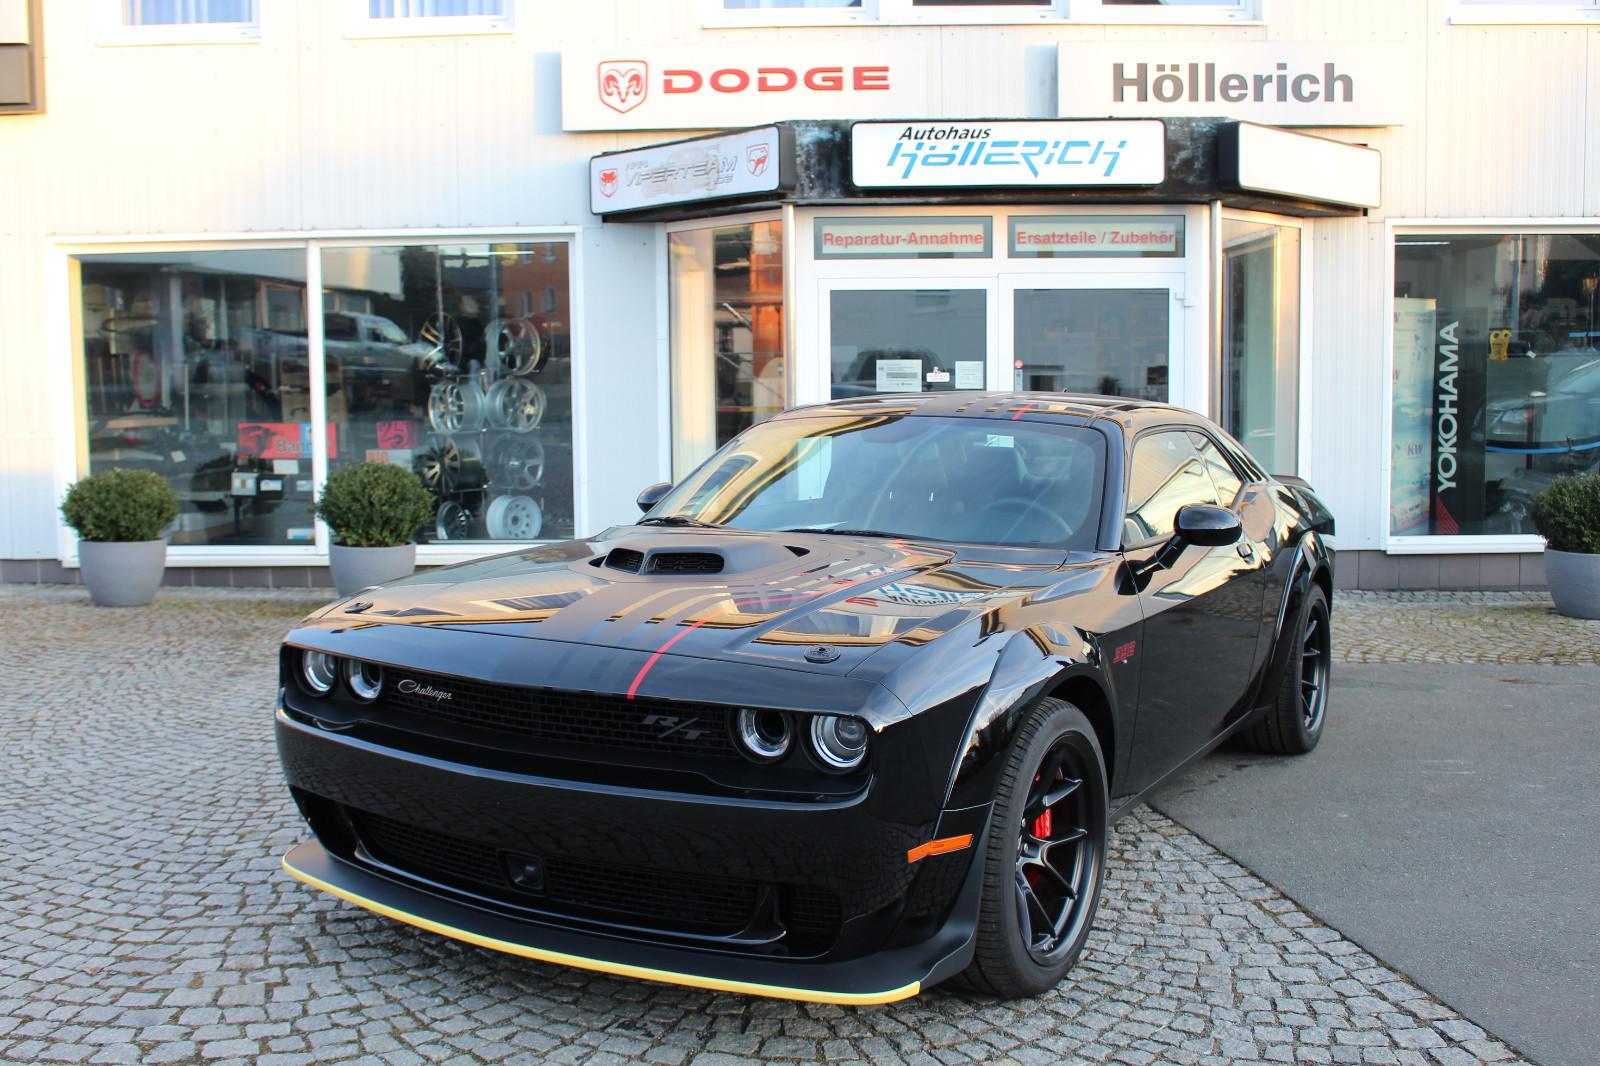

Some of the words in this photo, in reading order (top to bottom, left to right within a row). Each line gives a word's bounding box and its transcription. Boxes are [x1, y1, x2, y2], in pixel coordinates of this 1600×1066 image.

[663, 66, 890, 94] DODGE
[1113, 62, 1354, 103] Höllerich
[898, 126, 992, 141] Autohaus
[822, 231, 984, 249] Reparatur-Annahme
[1016, 231, 1097, 245] Ersatzteile
[1100, 231, 1108, 246] /
[1110, 230, 1175, 245] Zubehör
[1436, 320, 1460, 494] YOKOHAMA
[397, 679, 453, 702] Challenger
[641, 714, 712, 740] R/T
